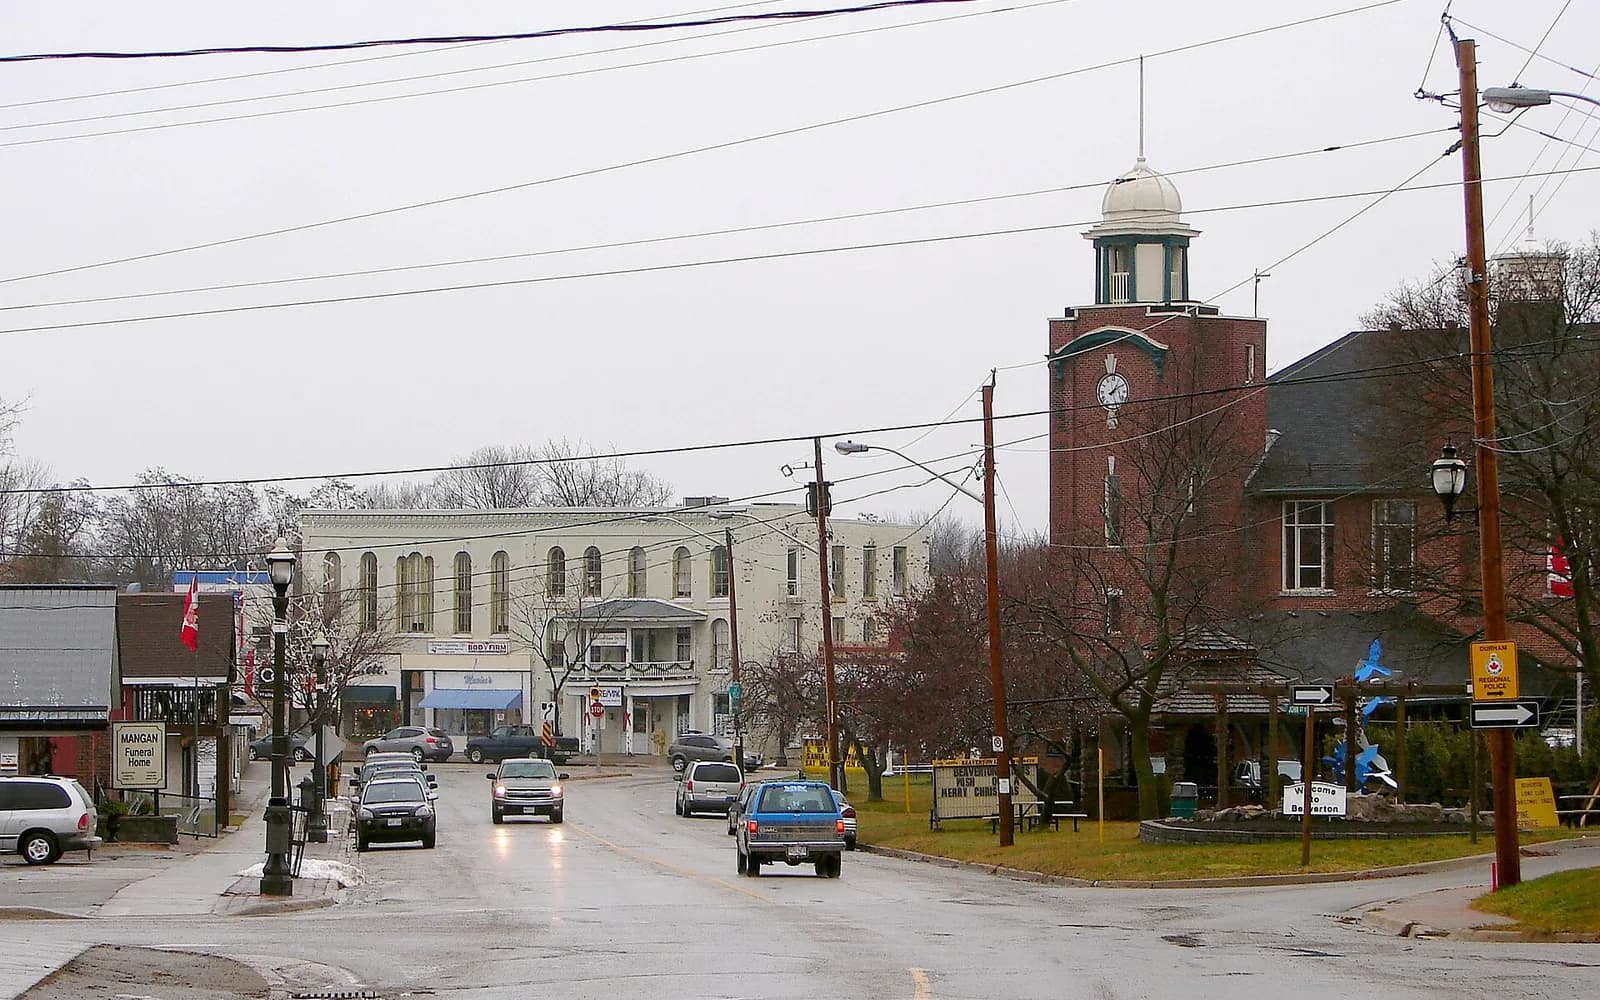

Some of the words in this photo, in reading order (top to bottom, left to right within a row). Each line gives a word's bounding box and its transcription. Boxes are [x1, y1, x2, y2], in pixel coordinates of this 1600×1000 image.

[121, 733, 158, 743] MANGAN
[125, 747, 154, 757] Funeral
[128, 757, 151, 767] Home
[941, 787, 967, 798] MERRY
[974, 786, 1019, 796] CHRISAS
[1294, 786, 1336, 796] Wcome
[1291, 804, 1339, 813] Beverton
